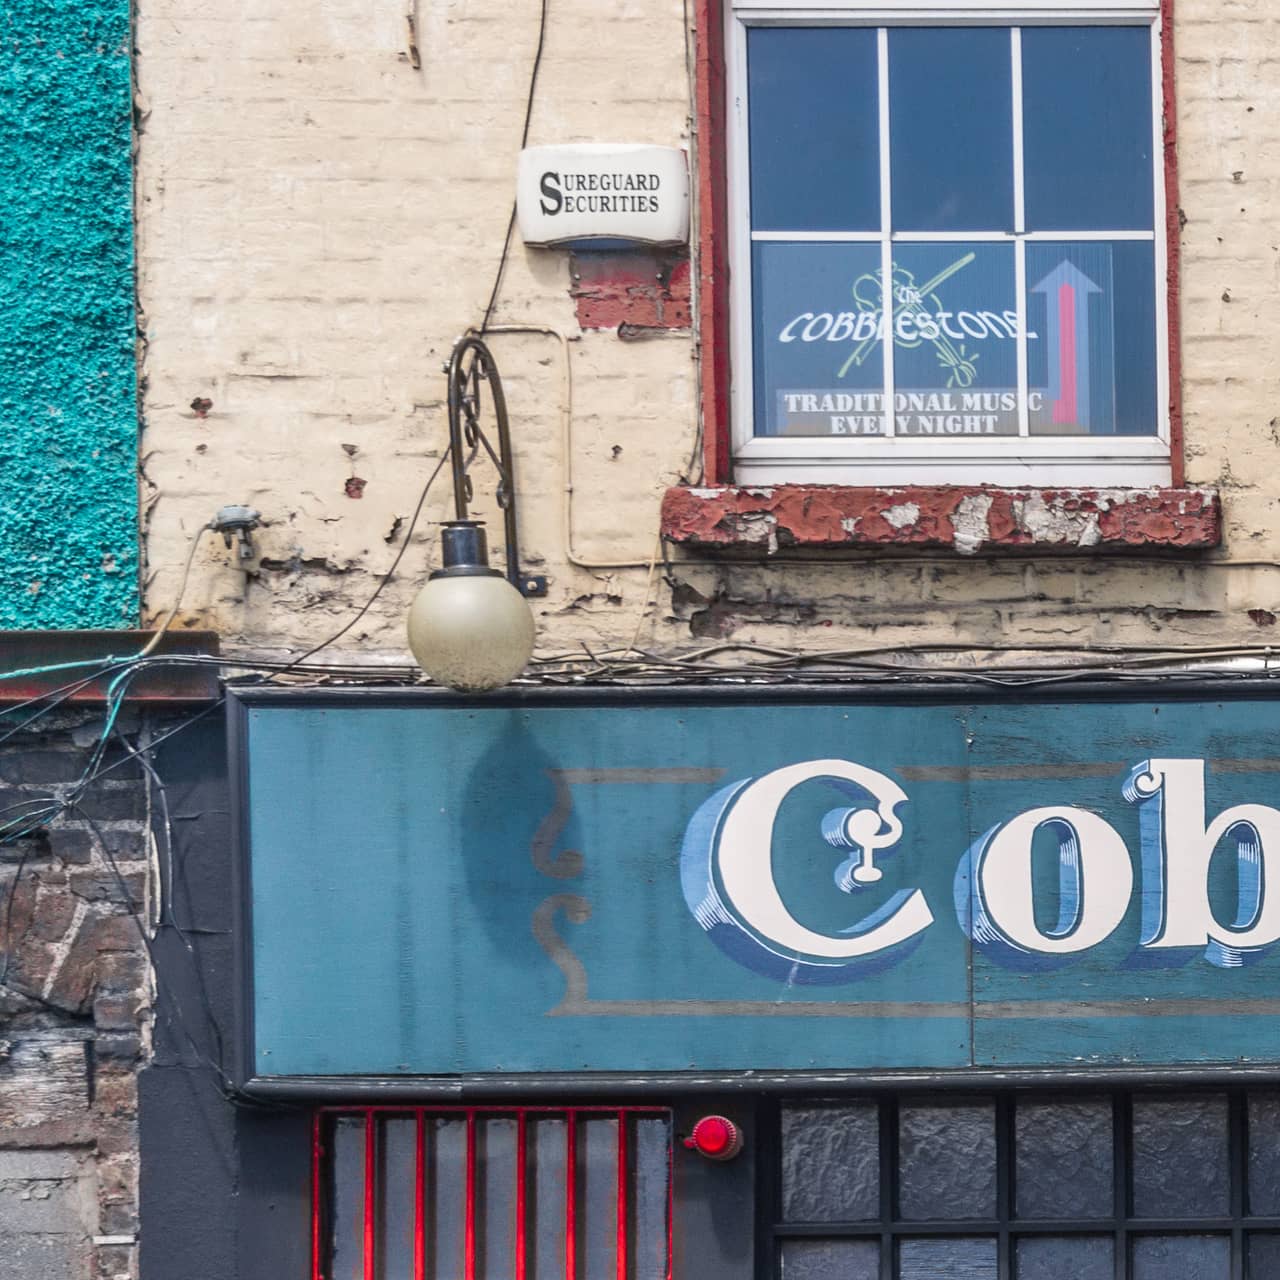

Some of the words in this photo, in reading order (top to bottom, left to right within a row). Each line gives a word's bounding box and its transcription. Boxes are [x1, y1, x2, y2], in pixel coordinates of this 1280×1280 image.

[784, 392, 956, 412] TRADITONAL
[961, 392, 1042, 412] MUSC
[919, 414, 998, 434] NIGHT
